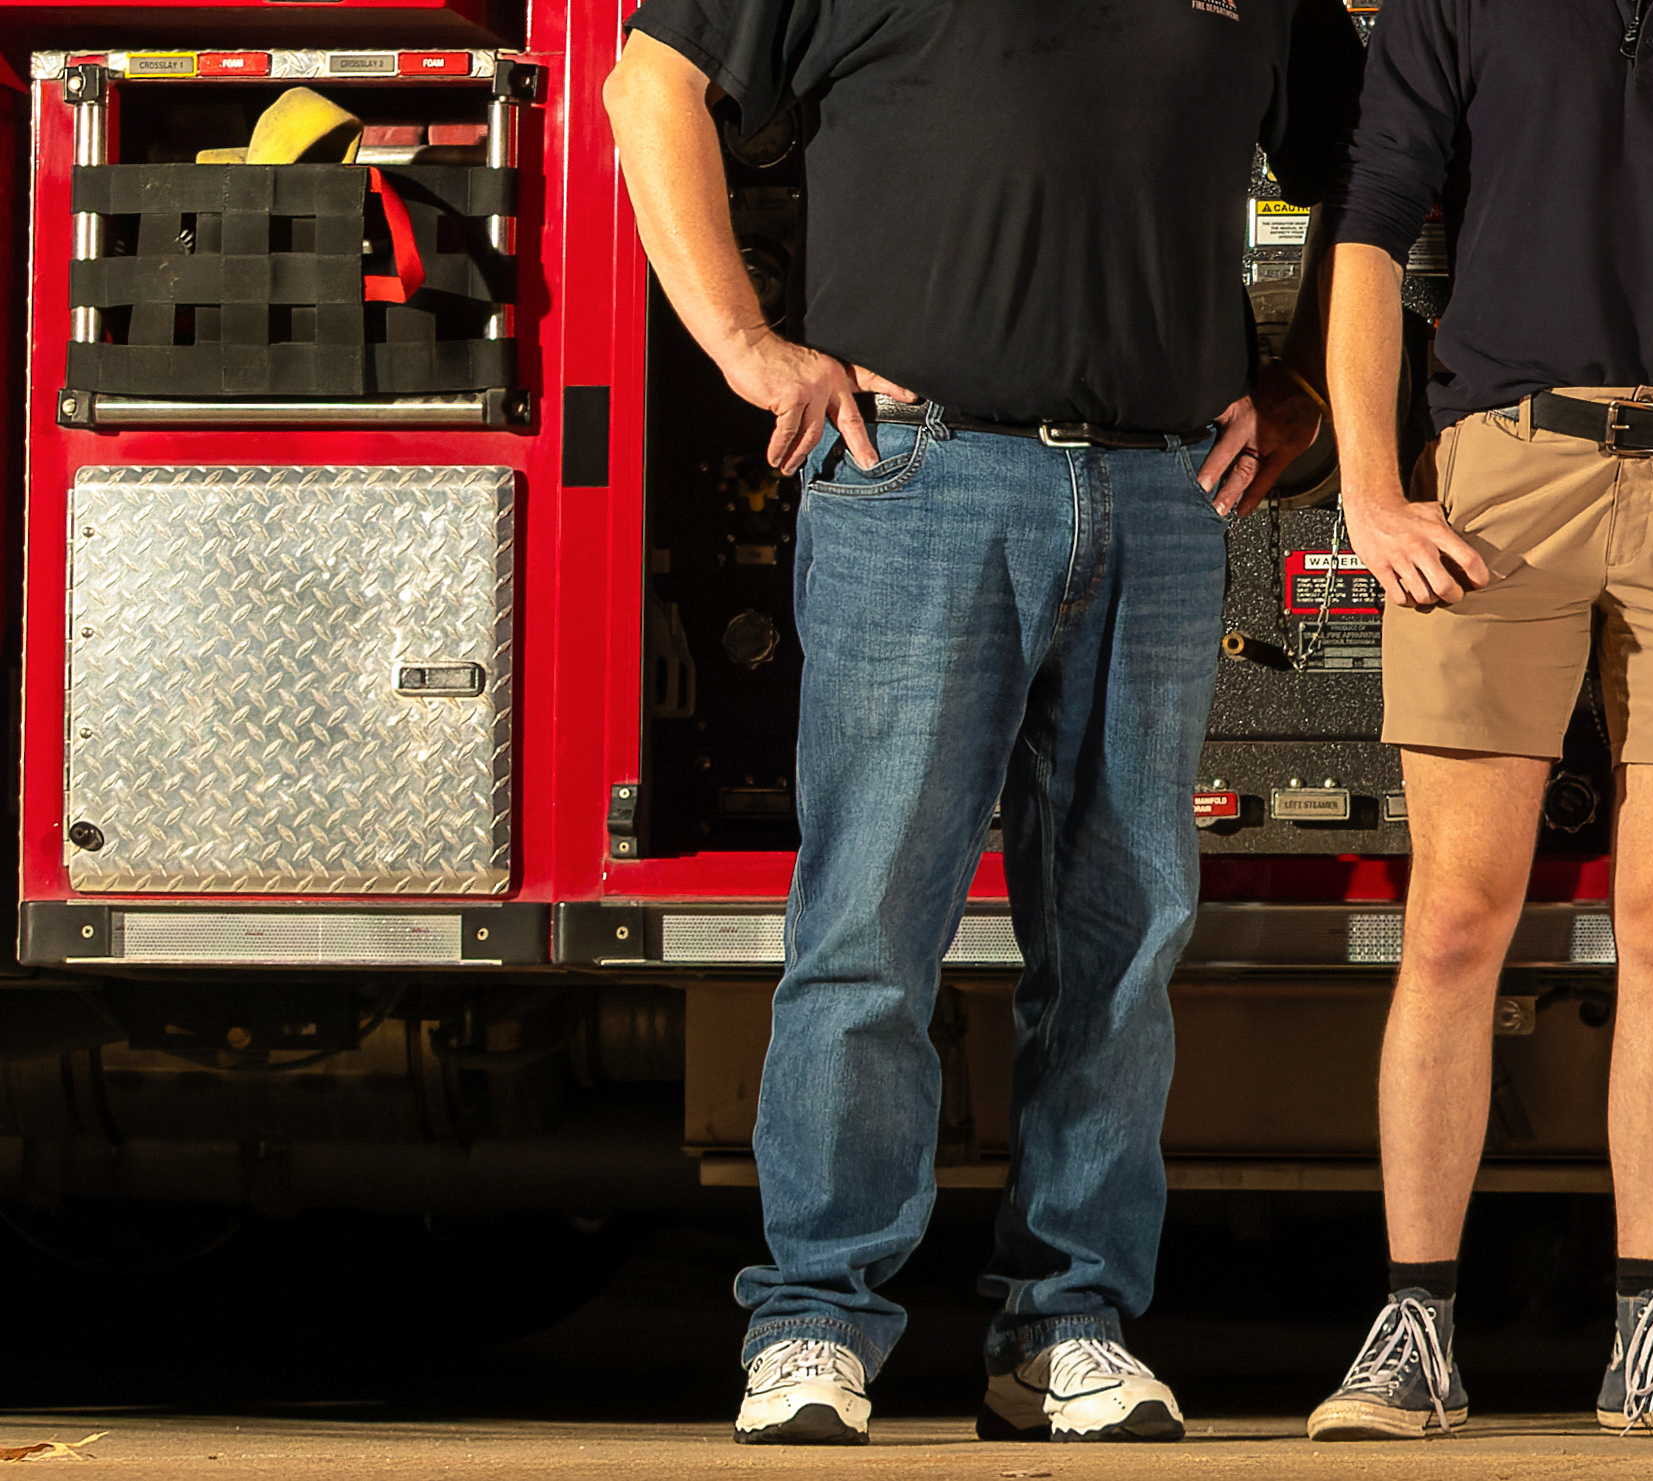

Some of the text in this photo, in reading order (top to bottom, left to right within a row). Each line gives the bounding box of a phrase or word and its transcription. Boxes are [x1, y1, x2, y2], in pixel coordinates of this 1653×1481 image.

[223, 59, 244, 68] FOAM
[341, 60, 378, 68] CROSSLAY
[423, 59, 445, 67] FOAM
[1195, 797, 1227, 805] MANIFOLD
[1285, 801, 1338, 809] LEFT STEAMER
